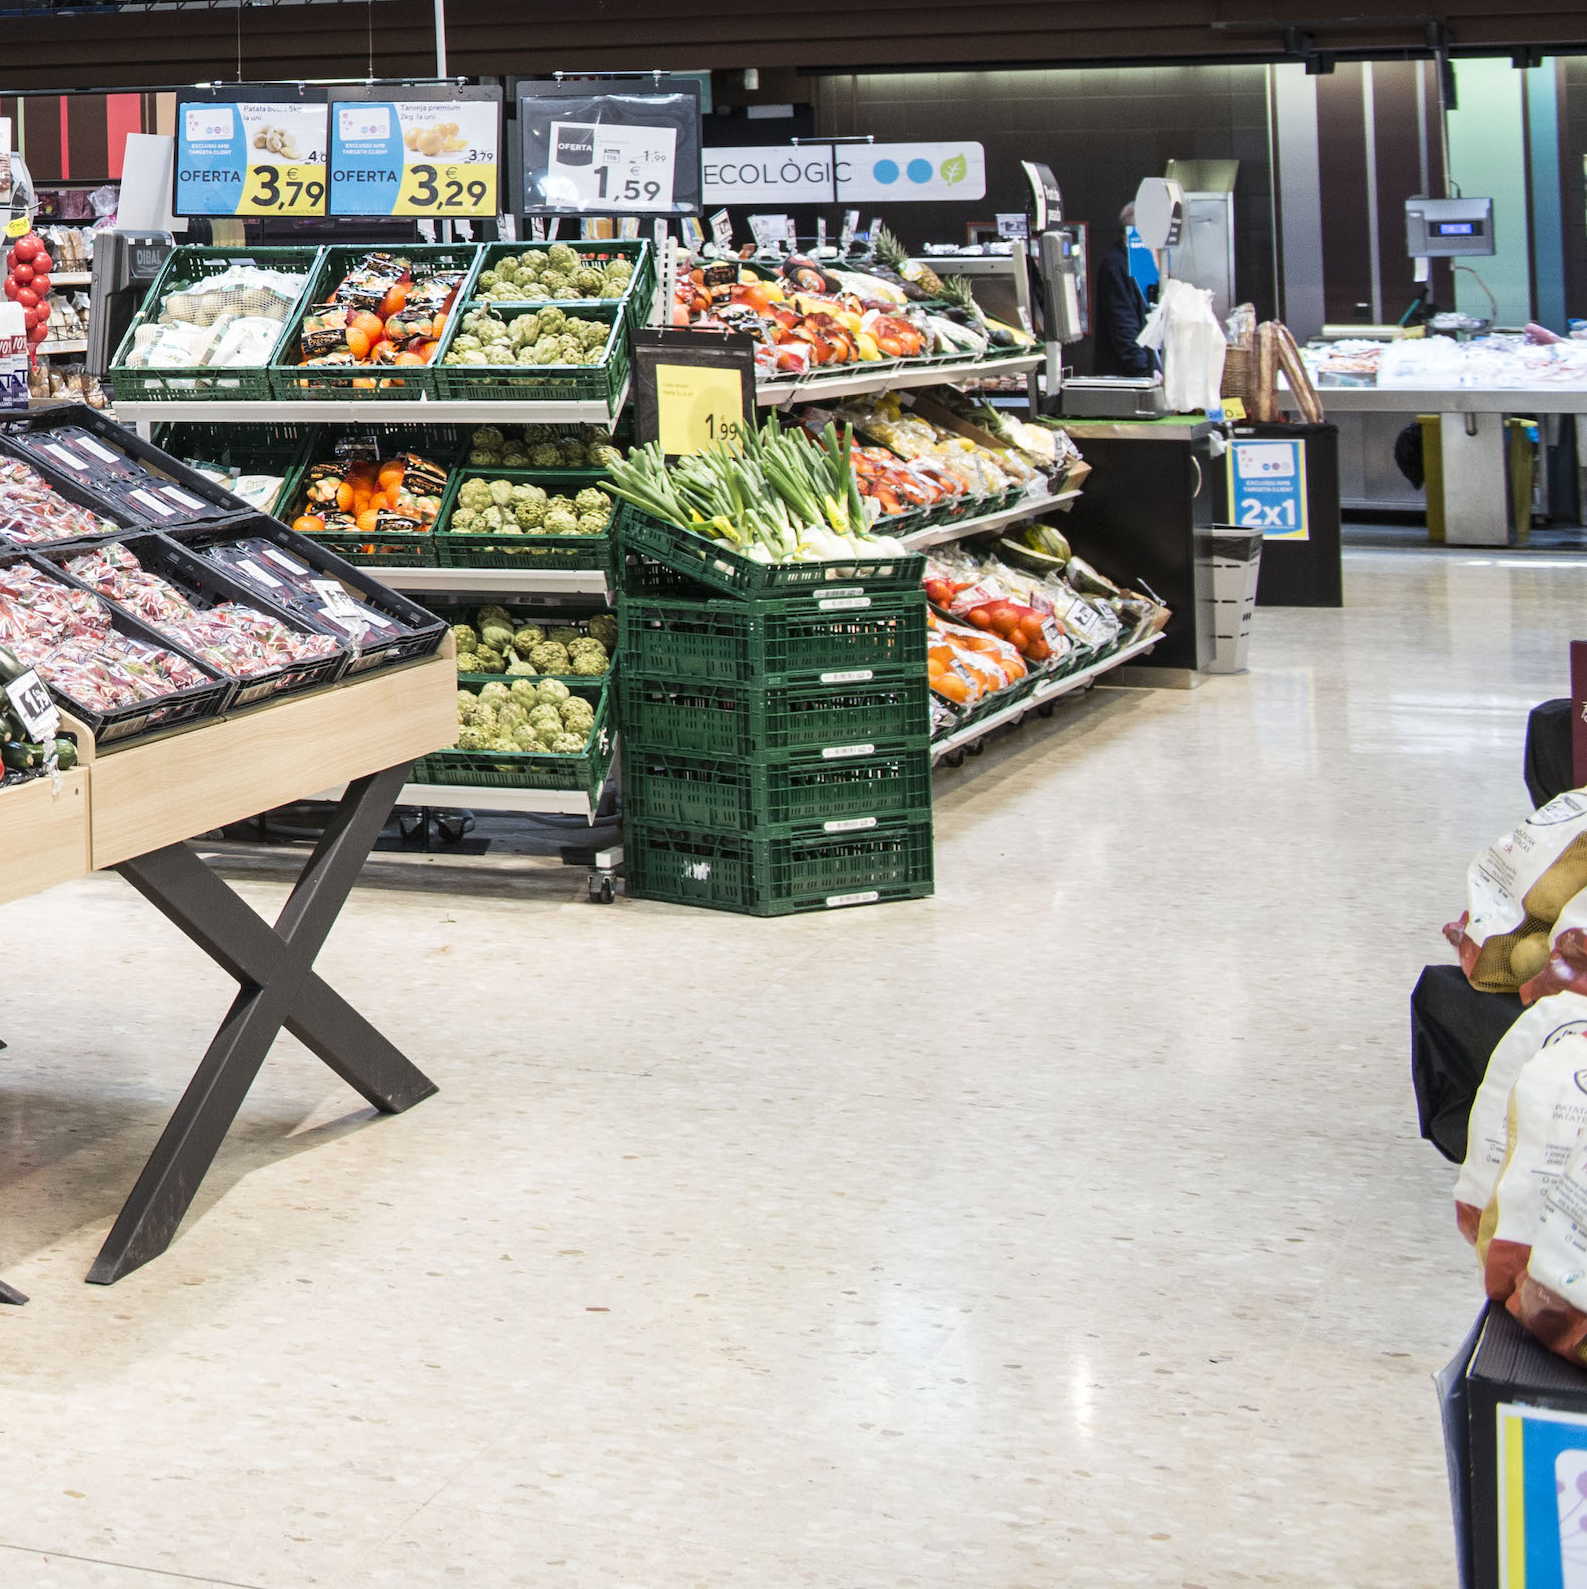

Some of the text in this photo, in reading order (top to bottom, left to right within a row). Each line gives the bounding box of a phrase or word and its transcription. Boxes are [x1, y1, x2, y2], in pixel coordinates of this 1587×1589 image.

[243, 105, 267, 113] Patata
[400, 104, 461, 113] Taronja premium
[557, 142, 593, 152] OFERTA
[179, 169, 241, 183] OFERTA
[332, 169, 397, 183] OFERTA
[594, 165, 661, 202] 1,59
[704, 158, 853, 186] ECOLÒGIC
[250, 165, 325, 210] 3,79
[408, 164, 488, 210] 3,29
[704, 413, 738, 441] 1,99
[1241, 498, 1297, 526] 2x1
